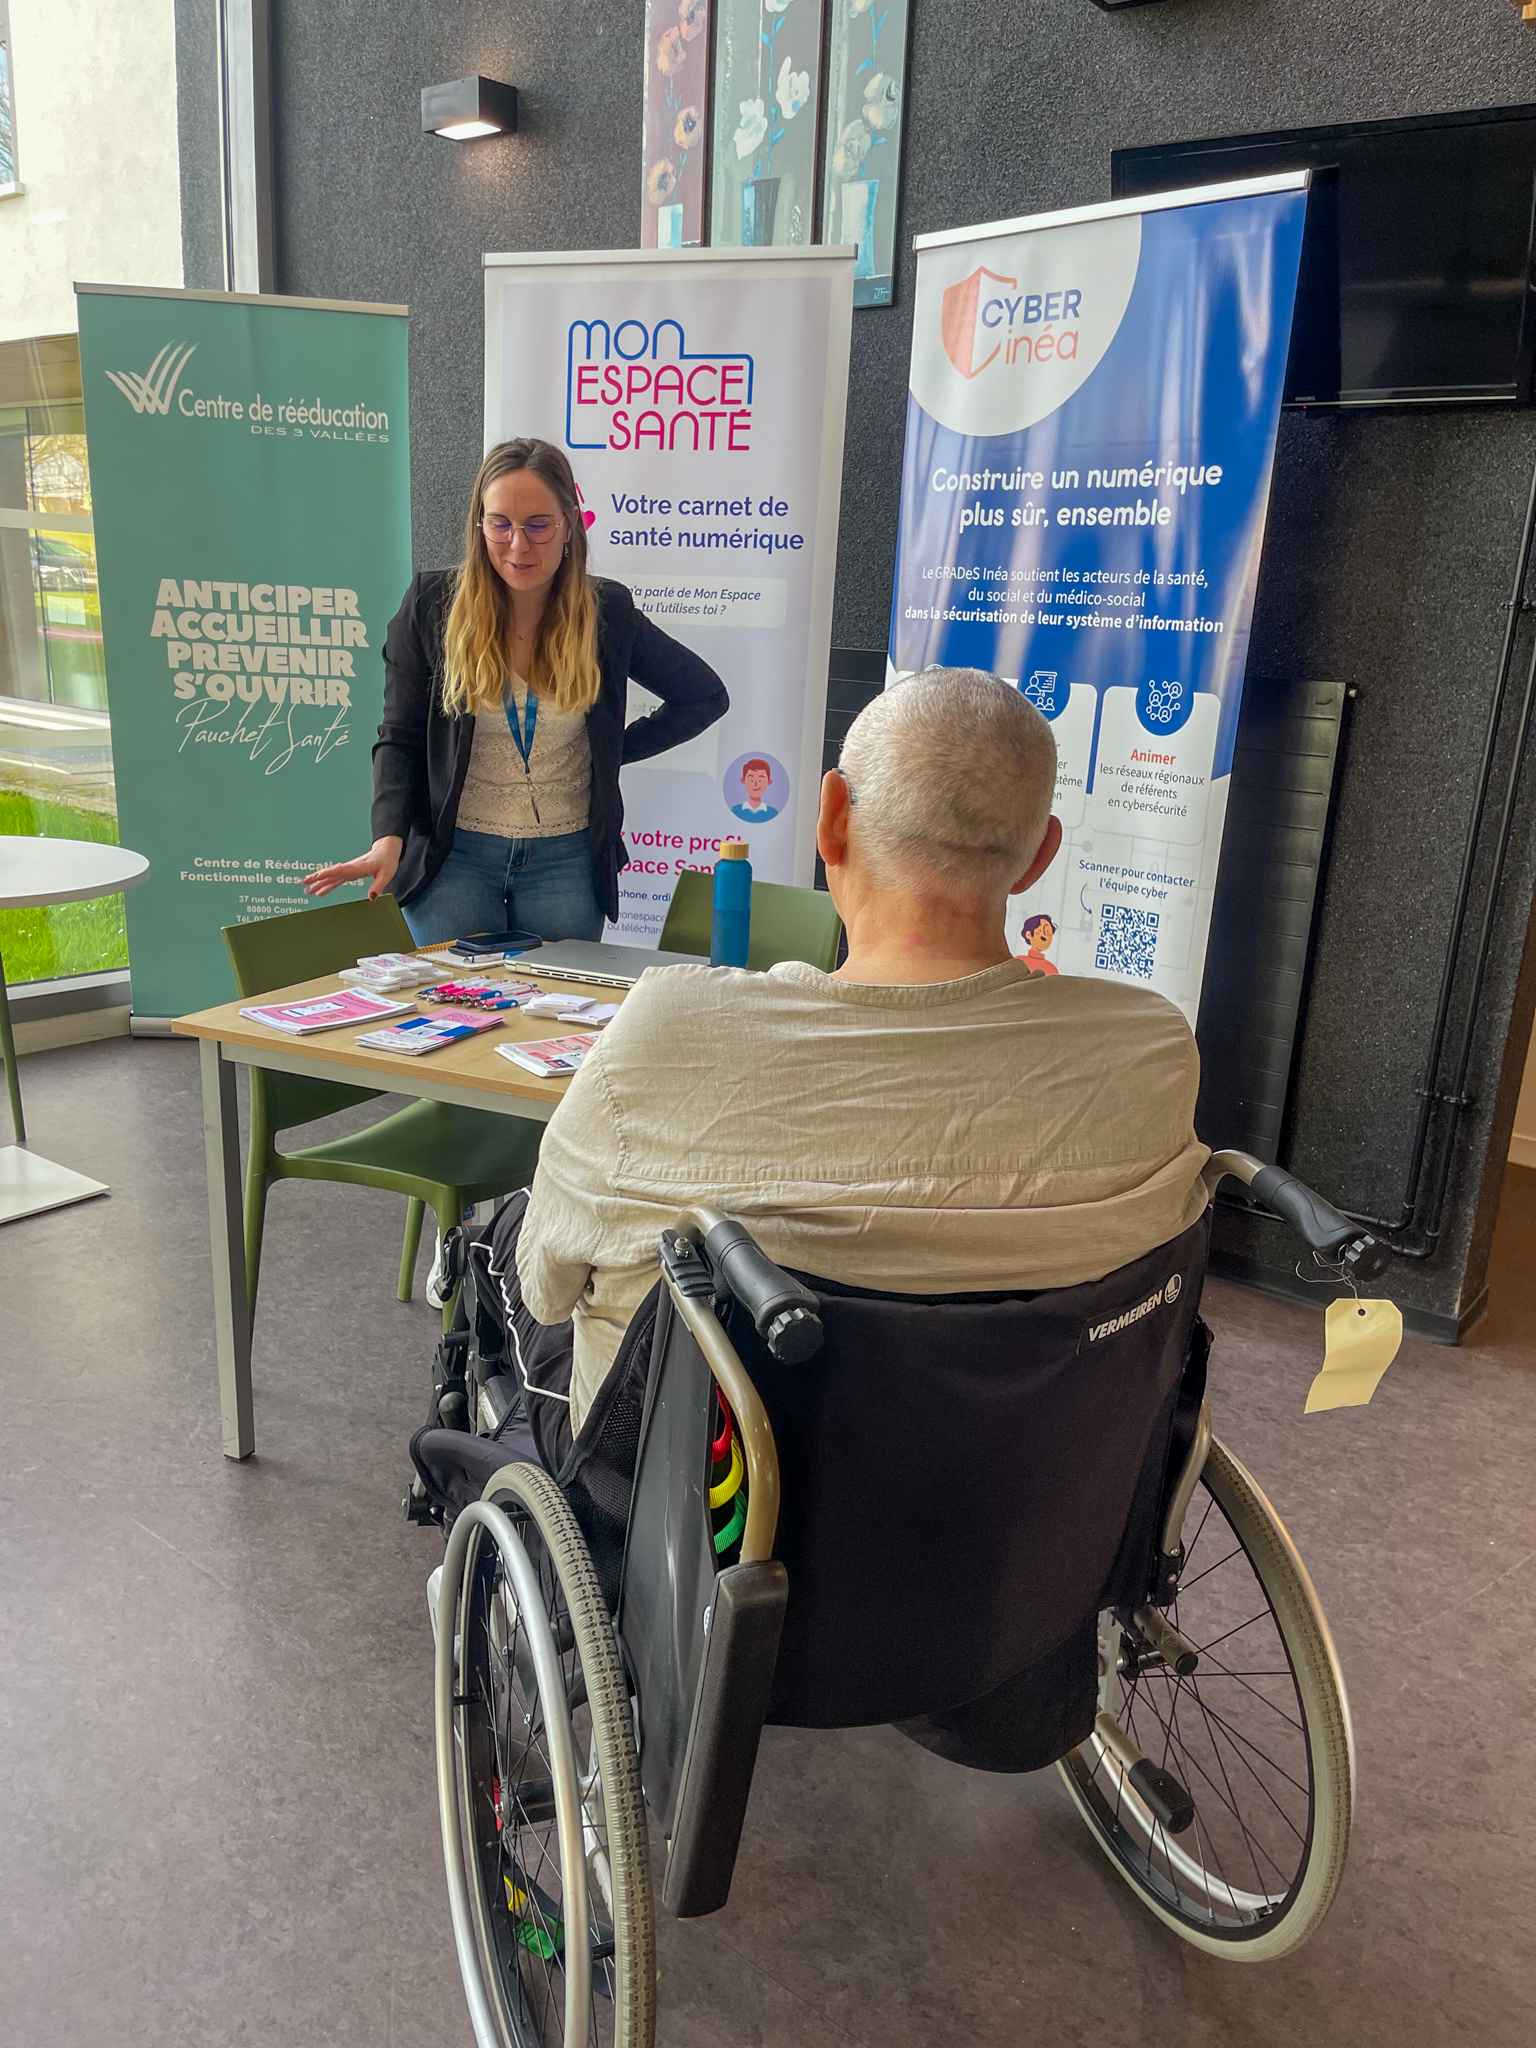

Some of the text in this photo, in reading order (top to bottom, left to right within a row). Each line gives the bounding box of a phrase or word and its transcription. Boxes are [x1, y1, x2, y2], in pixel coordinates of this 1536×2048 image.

[980, 288, 1083, 329] CYBER
[1004, 323, 1080, 366] inéa
[576, 364, 744, 406] ESPACE
[178, 389, 390, 430] Centre de rééducation
[251, 425, 390, 443] DES 3 VALLÉES
[608, 409, 752, 451] SANTÉ
[932, 460, 1223, 495] Construire un numérique
[610, 493, 790, 517] Votre carnet de
[958, 499, 1172, 534] plus sûr, ensemble
[609, 526, 804, 555] santé numérique
[922, 565, 1209, 589] Le GRADeS Inéa soutient les acteurs de la santé,
[155, 579, 361, 617] ANTICIPER
[643, 586, 675, 600] parlé
[676, 587, 692, 599] de
[693, 588, 718, 600] Mon
[720, 588, 761, 603] Espace
[968, 587, 1146, 608] du social et du médico-social
[642, 602, 654, 613] tu
[703, 604, 718, 615] toi
[719, 604, 727, 616] ?
[904, 606, 929, 620] dans
[930, 606, 940, 620] la
[942, 605, 1017, 624] sécurisation
[1019, 609, 1035, 624] de
[1037, 610, 1064, 627] leur
[1065, 611, 1123, 630] système
[150, 609, 370, 648] ACCUEILLIR
[175, 696, 286, 761] Pauchet
[1129, 748, 1177, 766] Animer
[1099, 762, 1205, 786] les réseaux régionaux
[1120, 781, 1178, 800] de référents
[1107, 798, 1188, 818] en cybersécurité
[630, 829, 684, 849] votre
[193, 857, 241, 869] Centre
[243, 858, 261, 869] de
[618, 858, 669, 876] pace
[1078, 859, 1195, 888] Scanner pour contacter
[179, 870, 301, 885] Fonctionnelle des
[238, 895, 249, 903] 37
[267, 895, 309, 905] Gambetta
[651, 893, 671, 902] ordi
[1140, 886, 1169, 900] cyber
[246, 905, 272, 914] 80800
[1088, 1290, 1162, 1342] VERMEIREN
